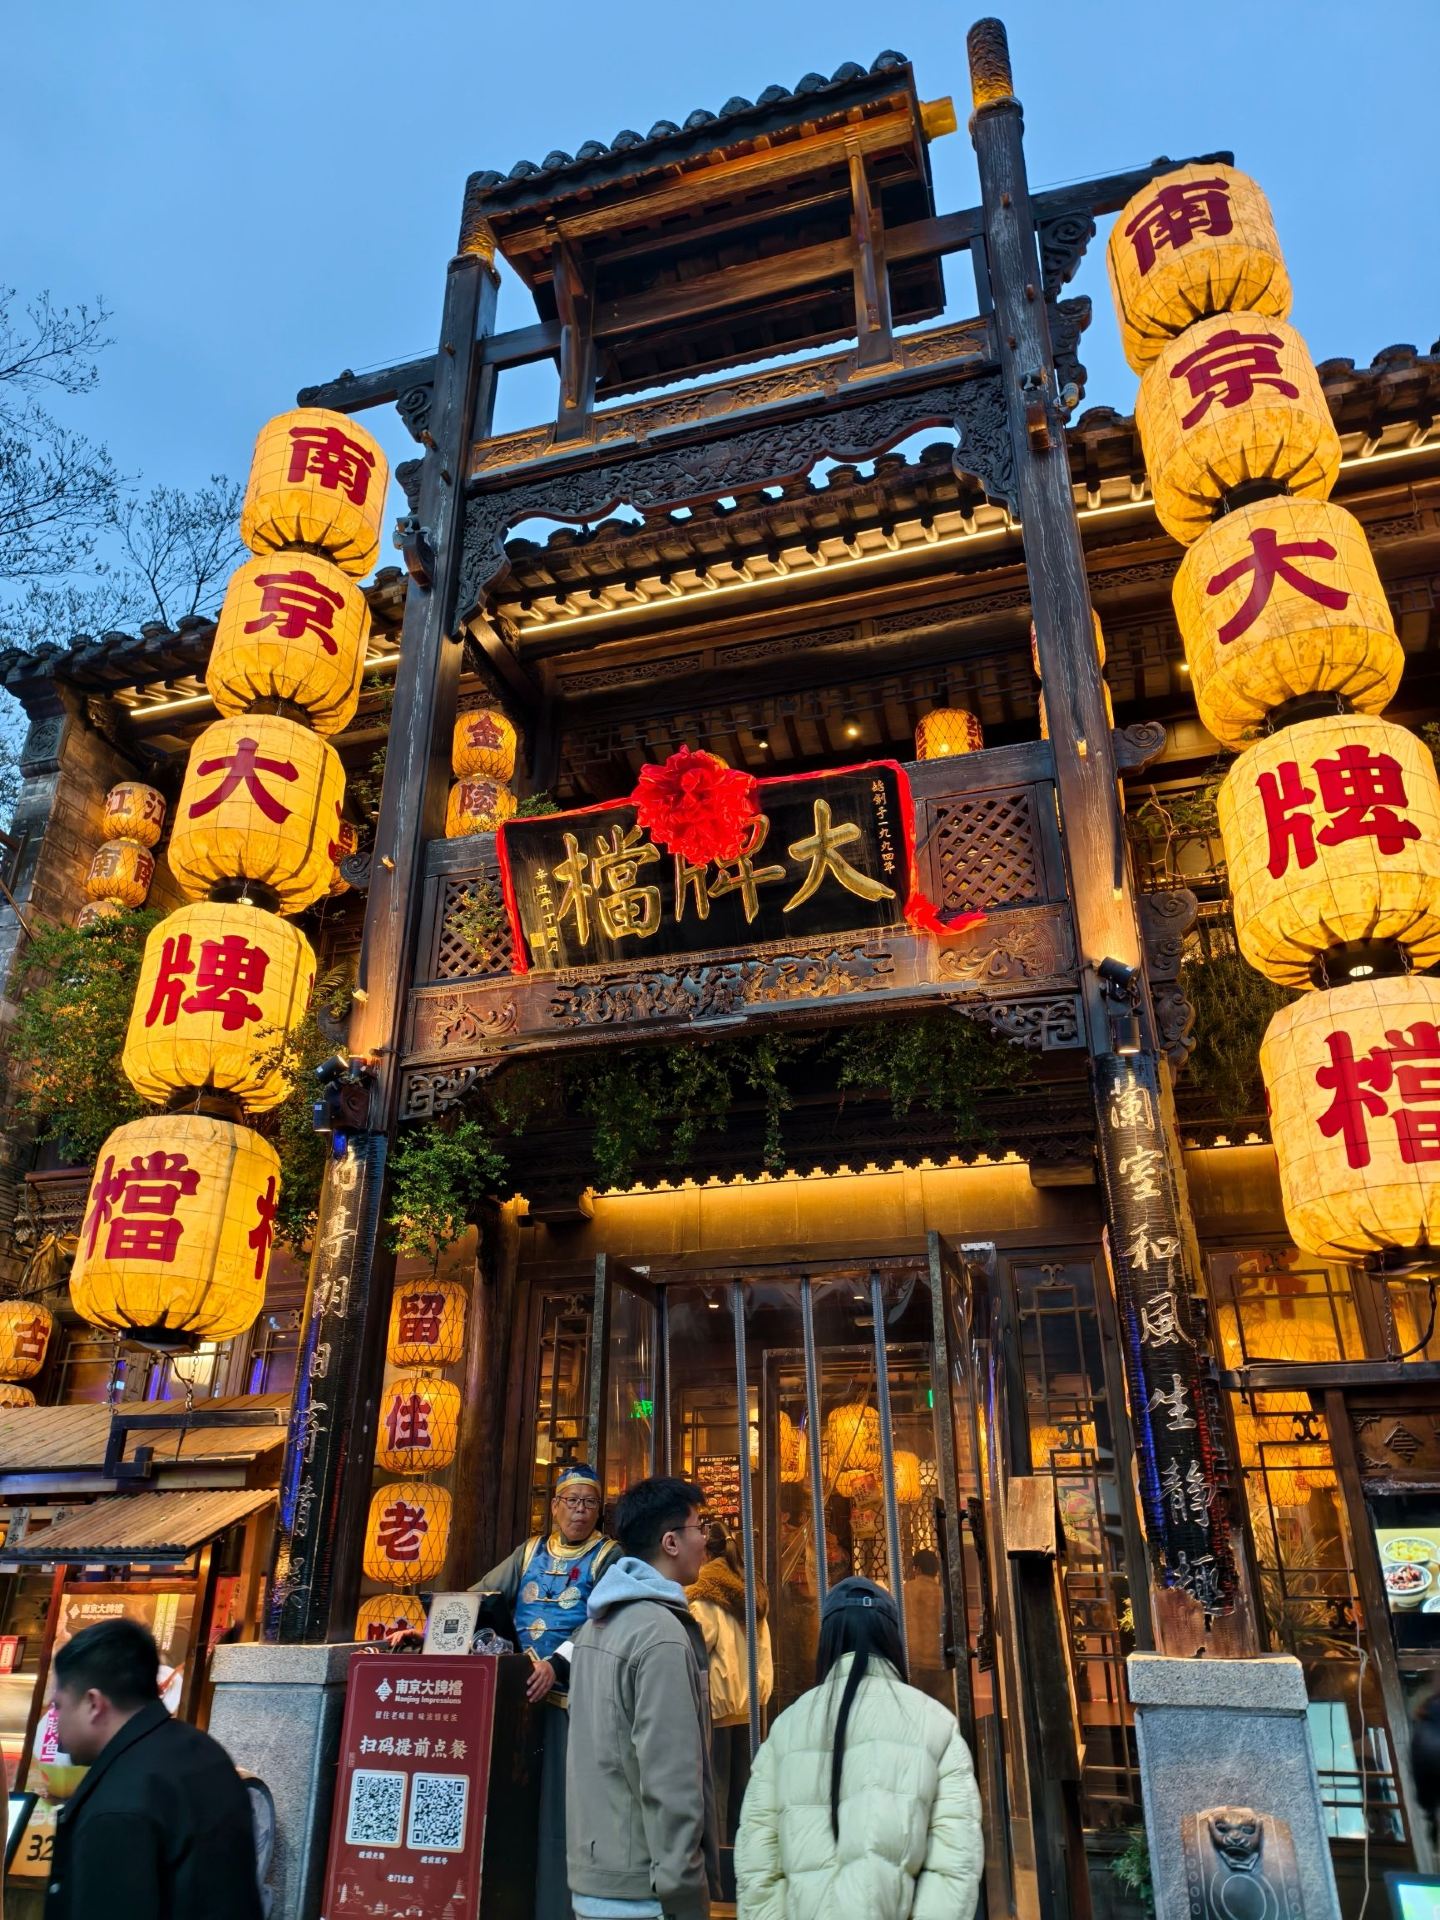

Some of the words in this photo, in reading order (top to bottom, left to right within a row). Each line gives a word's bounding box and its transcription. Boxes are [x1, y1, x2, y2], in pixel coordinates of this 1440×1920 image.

[459, 715, 504, 820] 金陵
[359, 1735, 467, 1760] 扫码提前点餐
